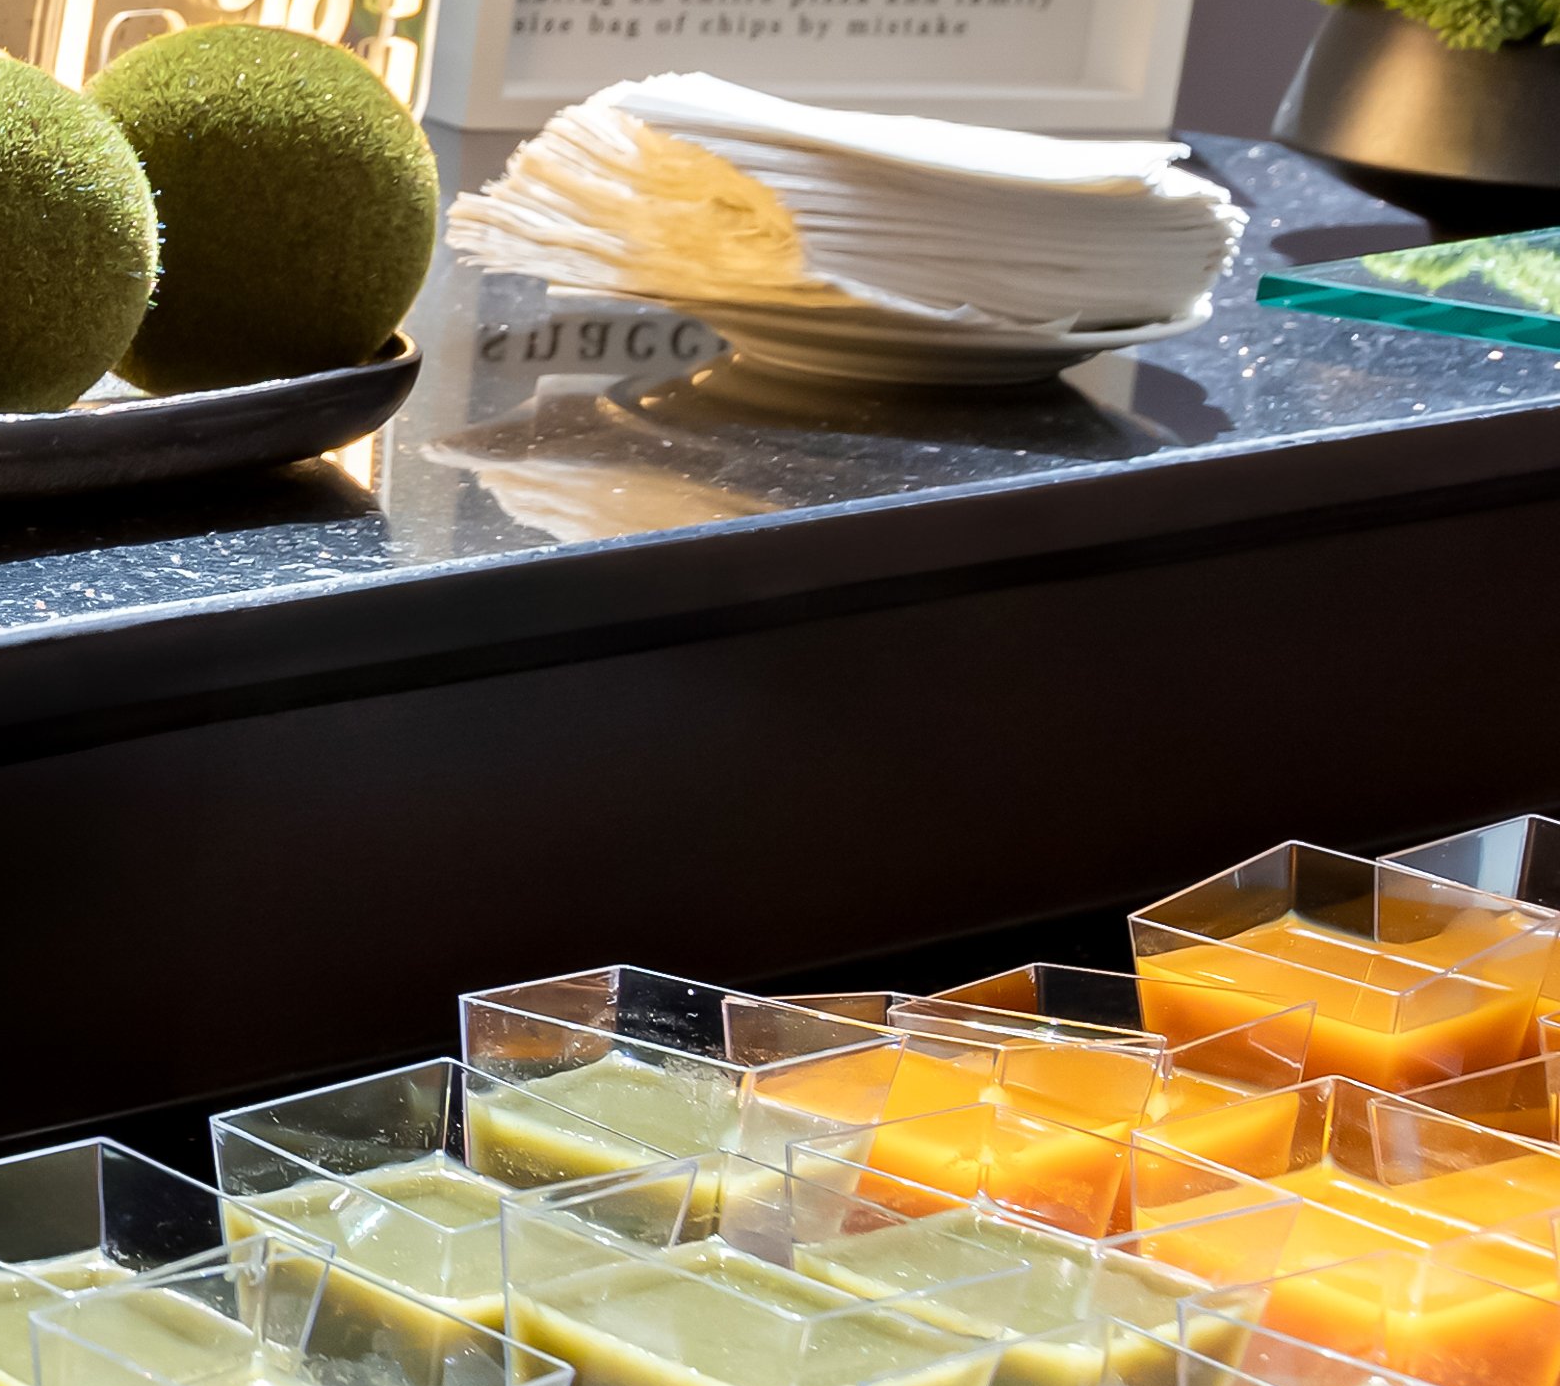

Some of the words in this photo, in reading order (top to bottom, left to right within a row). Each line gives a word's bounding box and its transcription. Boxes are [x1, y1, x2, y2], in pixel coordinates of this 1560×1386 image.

[514, 12, 575, 35] size
[587, 12, 641, 39] bag
[654, 12, 688, 35] of
[698, 13, 783, 41] chips
[796, 13, 833, 41] by
[845, 14, 970, 38] mistake
